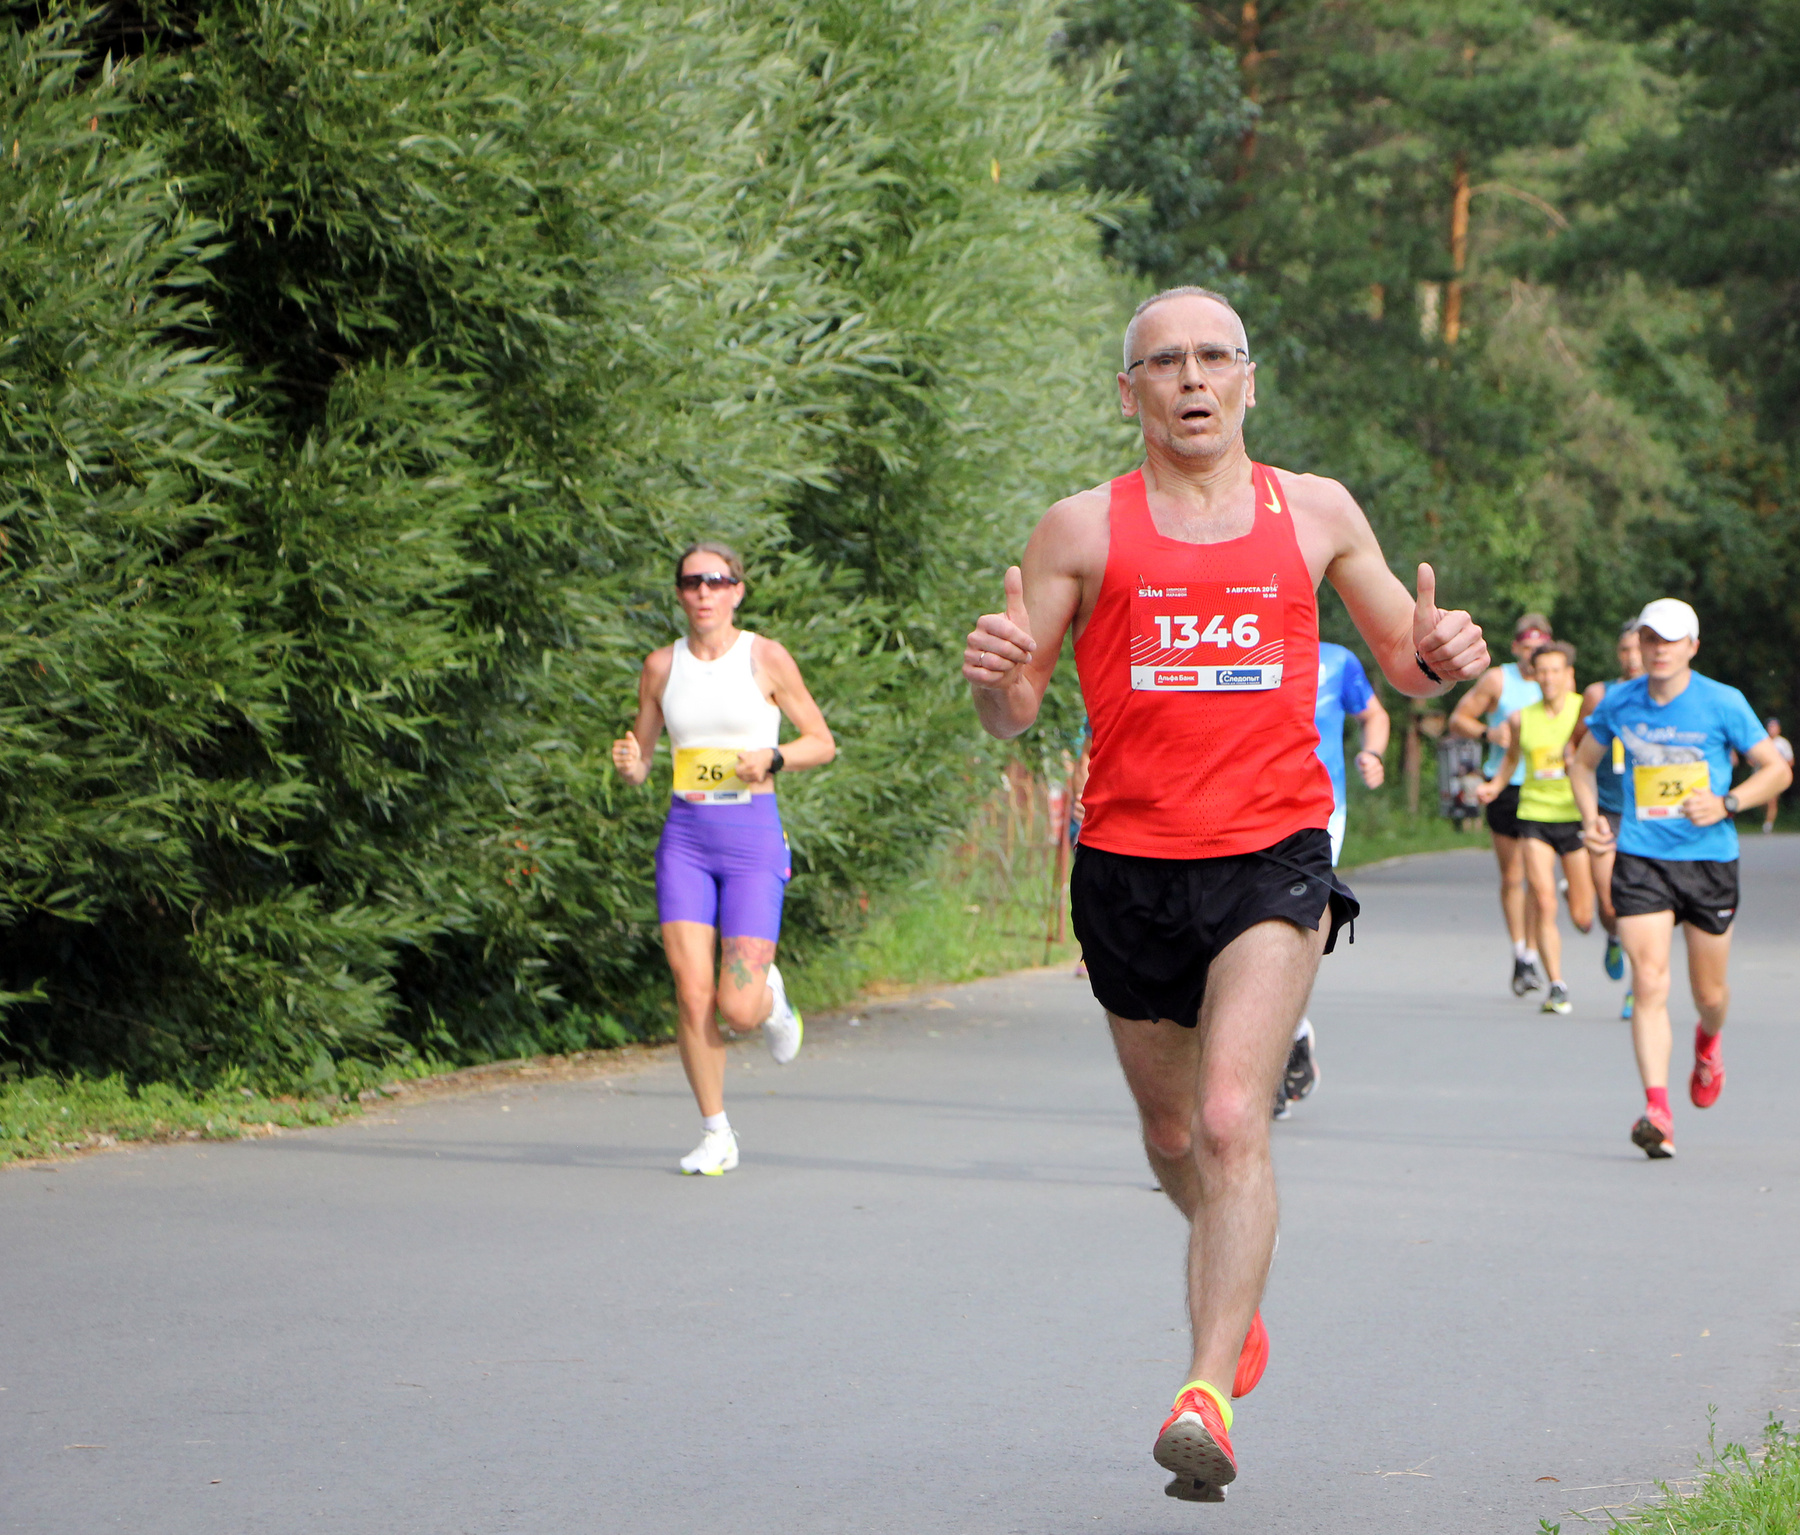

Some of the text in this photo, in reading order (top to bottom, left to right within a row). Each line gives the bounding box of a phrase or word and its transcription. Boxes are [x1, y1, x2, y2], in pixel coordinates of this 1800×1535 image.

[1154, 614, 1260, 649] 1346
[1158, 674, 1178, 682] Альфа
[696, 764, 723, 781] 26
[1659, 780, 1683, 797] 23
